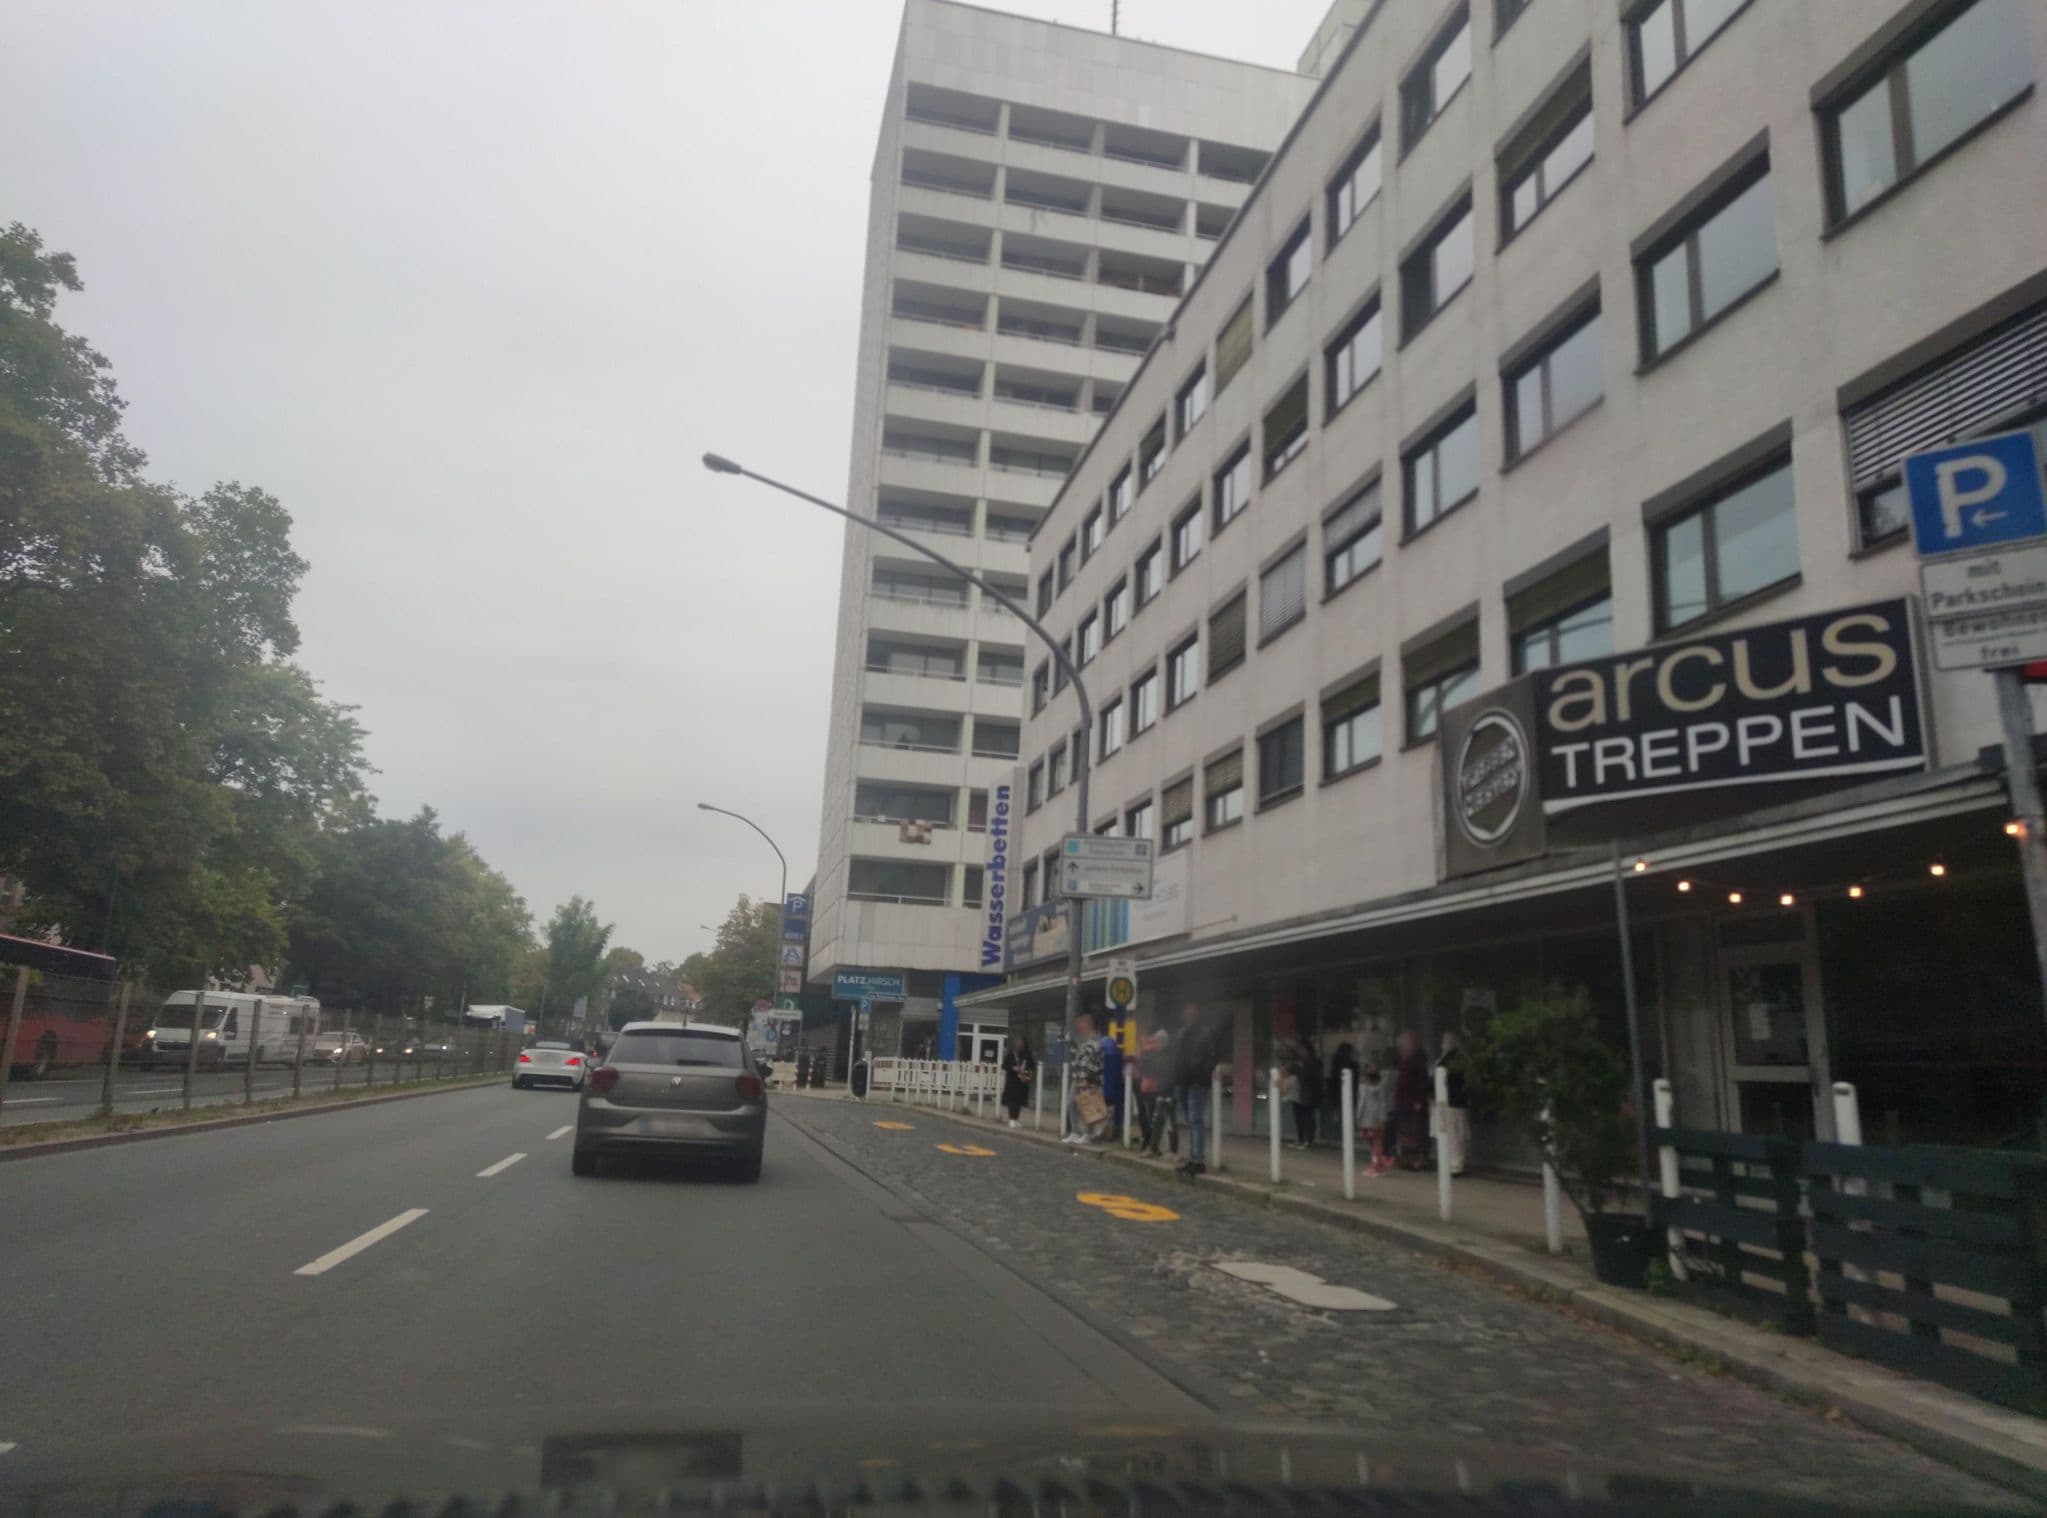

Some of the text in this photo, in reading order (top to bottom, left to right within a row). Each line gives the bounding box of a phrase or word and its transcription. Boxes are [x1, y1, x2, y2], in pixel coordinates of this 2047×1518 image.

[1935, 454, 2008, 539] P
[1547, 612, 1898, 733] arcus
[1551, 695, 1906, 789] TREPPEN
[981, 784, 1011, 968] Wasserbetten
